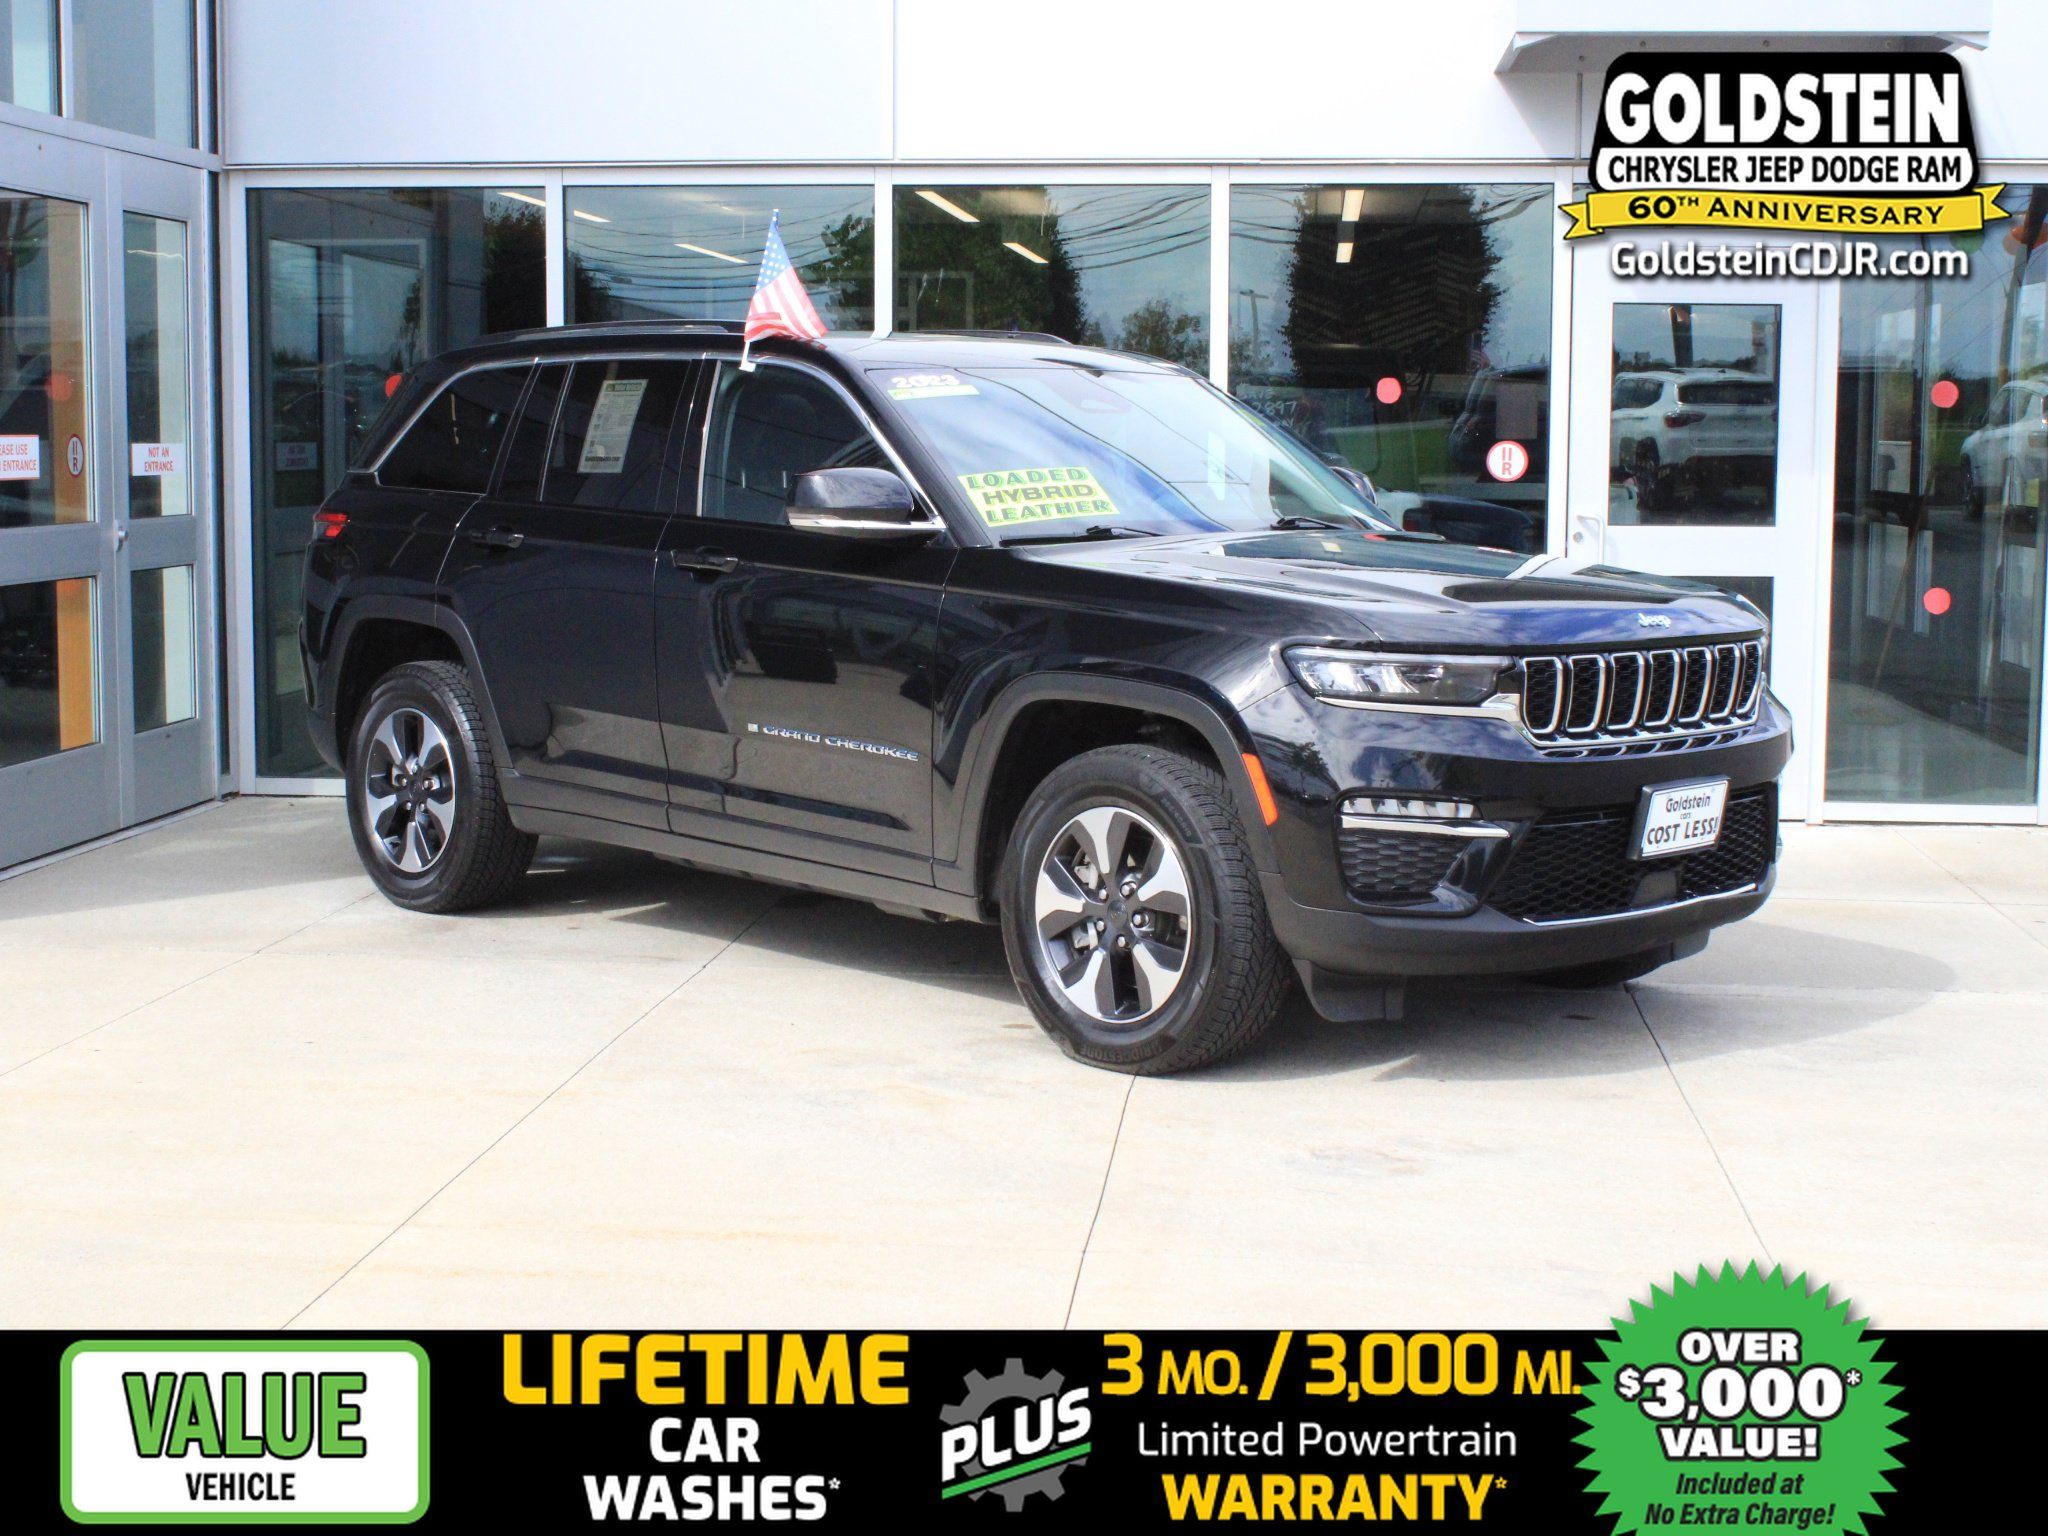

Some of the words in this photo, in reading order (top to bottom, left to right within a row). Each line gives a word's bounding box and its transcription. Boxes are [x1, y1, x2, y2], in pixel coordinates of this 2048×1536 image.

[16, 443, 28, 456] USE
[148, 446, 159, 458] NOT
[162, 446, 170, 457] AN
[3, 459, 37, 471] ENTRANCE
[144, 460, 174, 473] ENTRANCE
[1502, 462, 1512, 476] R
[966, 468, 1088, 490] LOADED
[982, 484, 1097, 506] HYBRID
[985, 500, 1112, 523] LEATHER
[1637, 612, 1672, 629] Jeep
[762, 725, 821, 743] GRAND
[825, 736, 919, 762] CHEROKEE
[1665, 793, 1711, 813] Goldstein
[1646, 823, 1680, 846] COST
[1683, 816, 1719, 840] LESS!
